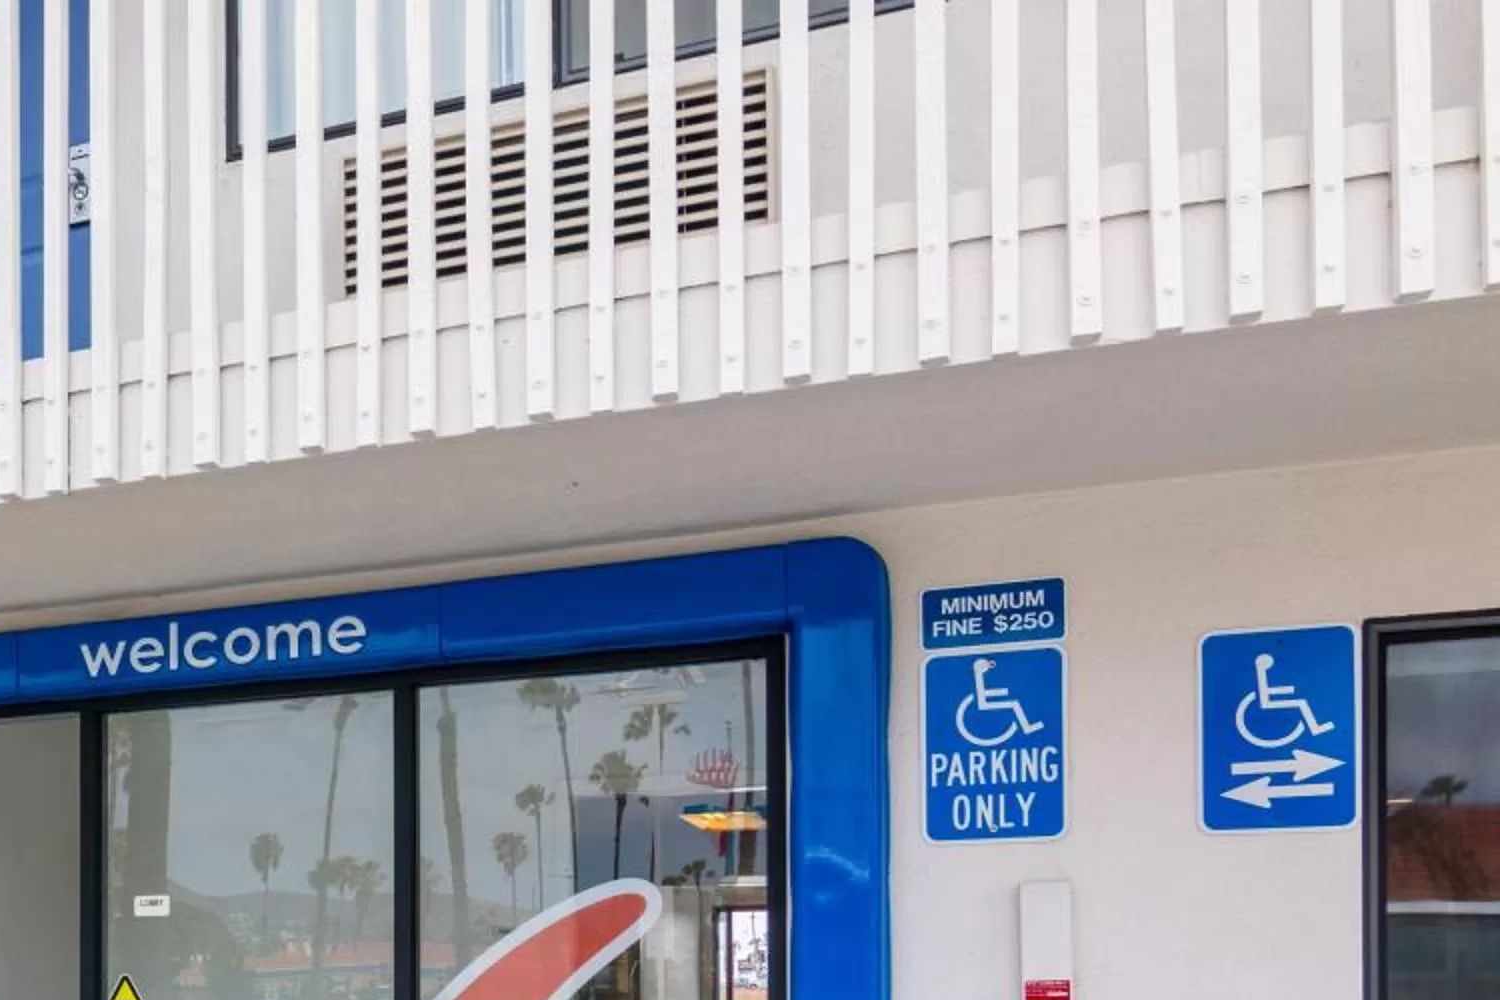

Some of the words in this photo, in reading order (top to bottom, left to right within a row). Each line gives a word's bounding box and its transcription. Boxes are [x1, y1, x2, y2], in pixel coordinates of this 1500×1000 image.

[941, 589, 1045, 615] MINIMUM
[932, 617, 983, 638] FINE
[993, 611, 1055, 634] $250
[80, 615, 367, 677] welcome
[931, 746, 1059, 787] PARKING
[952, 791, 1037, 832] ONLY
